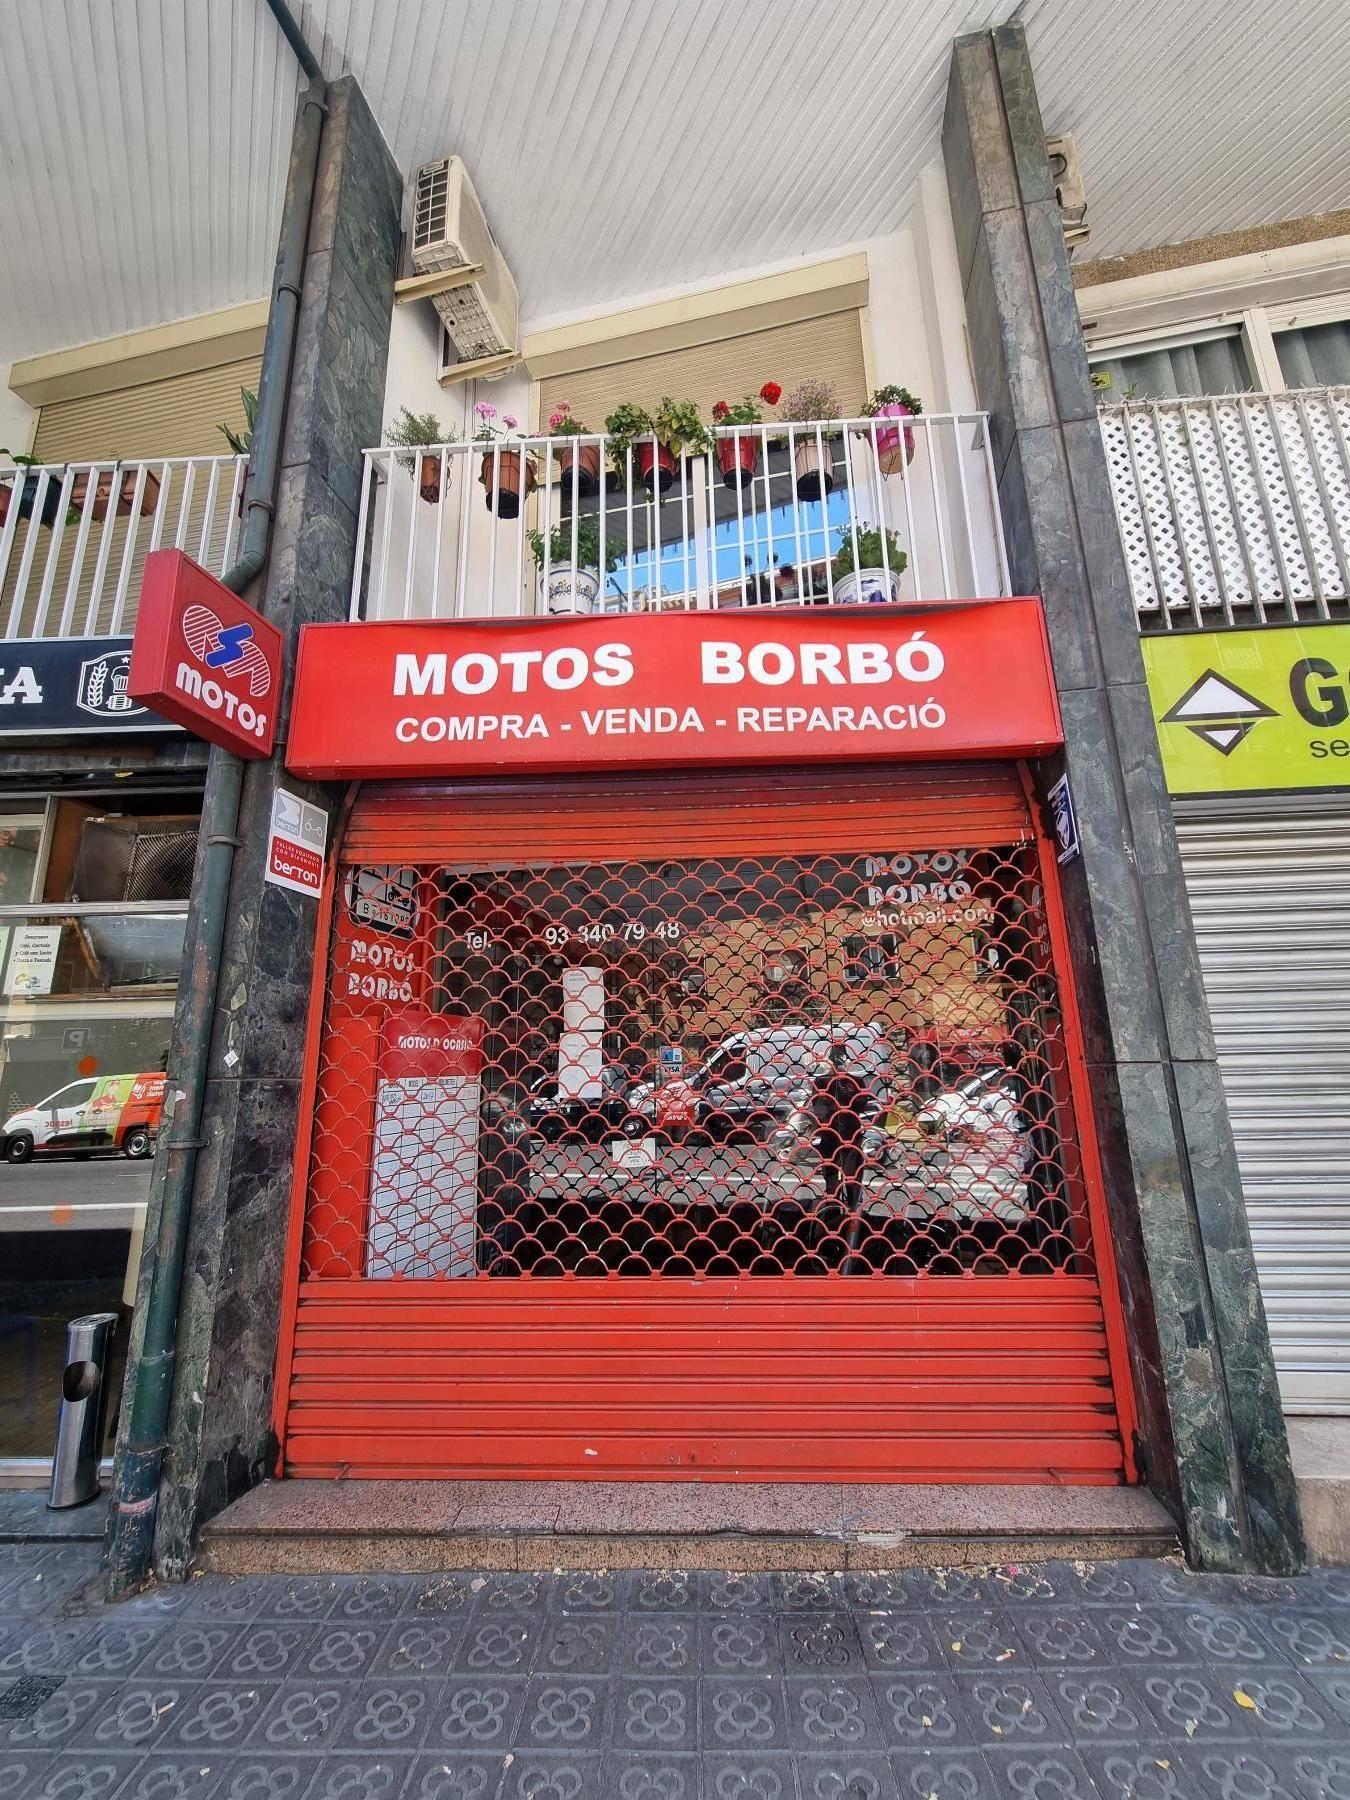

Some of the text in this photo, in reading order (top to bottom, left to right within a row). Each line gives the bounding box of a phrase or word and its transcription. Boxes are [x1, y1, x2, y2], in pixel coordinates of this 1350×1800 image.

[393, 631, 945, 696] MOTOS BORBÓ
[0, 667, 43, 704] A
[176, 662, 267, 737] MOTOS
[396, 713, 549, 743] COMPRA
[580, 707, 705, 736] VENDA
[737, 697, 946, 732] REPARACIÓ
[274, 855, 318, 885] berton
[866, 850, 968, 876] MOTOS
[466, 920, 680, 949] Tel. 93 340 79 48
[351, 940, 414, 973] MOTOS
